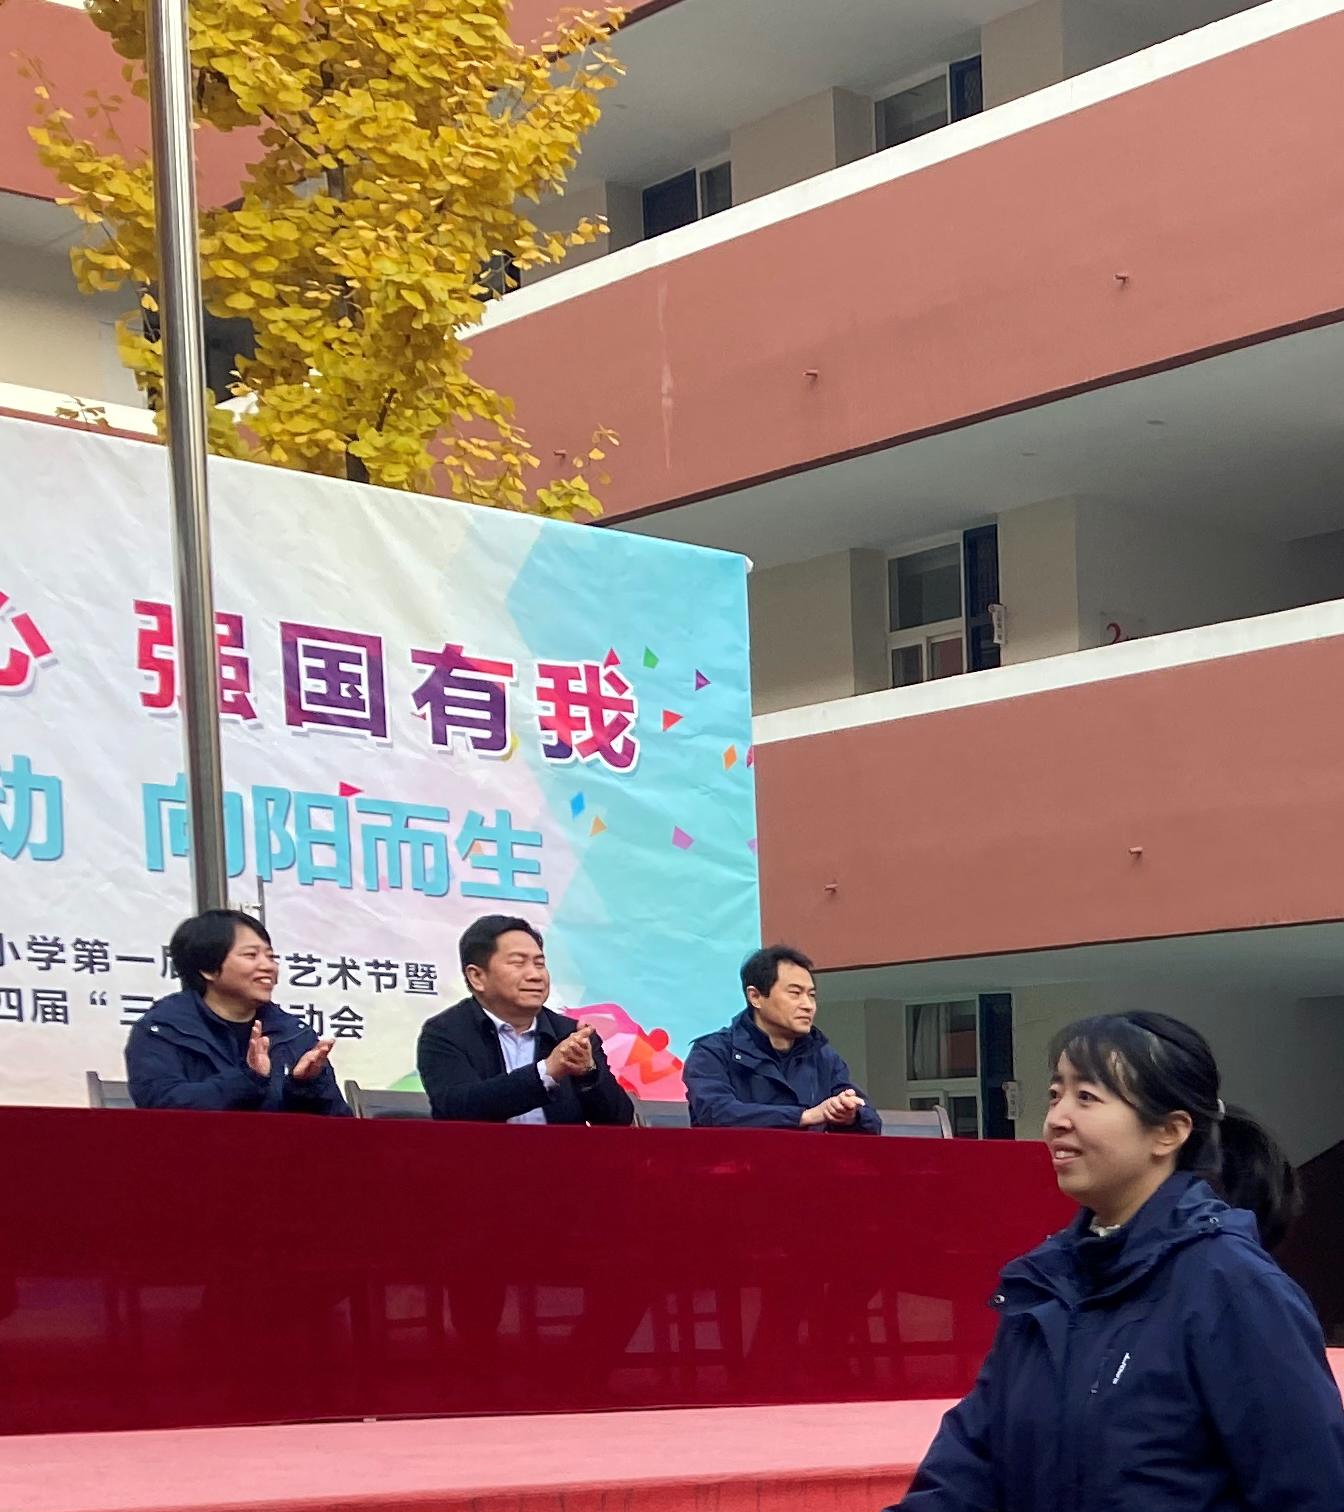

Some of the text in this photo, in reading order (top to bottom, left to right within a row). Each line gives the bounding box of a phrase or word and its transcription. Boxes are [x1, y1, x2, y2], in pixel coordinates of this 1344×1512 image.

[133, 599, 638, 770] 强国有我
[142, 773, 549, 904] 向阳而生
